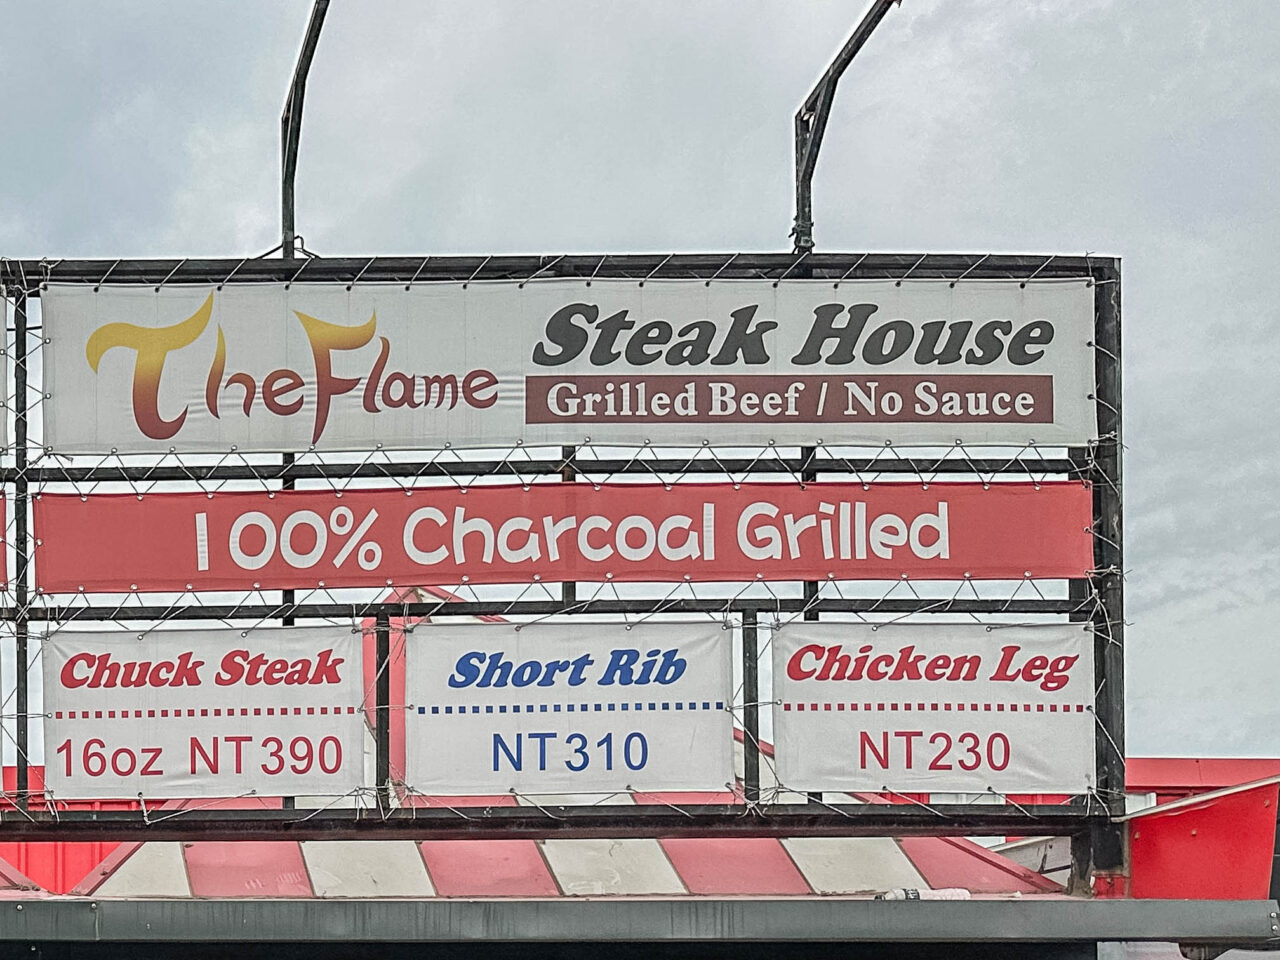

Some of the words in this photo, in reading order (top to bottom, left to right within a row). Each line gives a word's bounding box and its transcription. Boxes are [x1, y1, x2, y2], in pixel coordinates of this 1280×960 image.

[532, 303, 778, 367] Steak
[791, 303, 1055, 367] House
[547, 382, 699, 417] Grilled
[708, 381, 804, 416] Beef
[844, 382, 908, 416] No
[915, 382, 1035, 417] Sauce
[195, 505, 383, 573] 100%
[402, 502, 715, 566] Charcoal
[737, 501, 950, 561] Grilled
[60, 652, 205, 689] Chuck
[214, 649, 345, 687] Steak
[447, 651, 593, 689] Short
[597, 648, 687, 686] Rib
[786, 644, 983, 682] Chicken
[989, 645, 1079, 692] Leg
[56, 738, 163, 777] 16oz
[189, 735, 343, 775] NT390
[492, 732, 649, 772] NT310
[860, 731, 1011, 771] NT230
